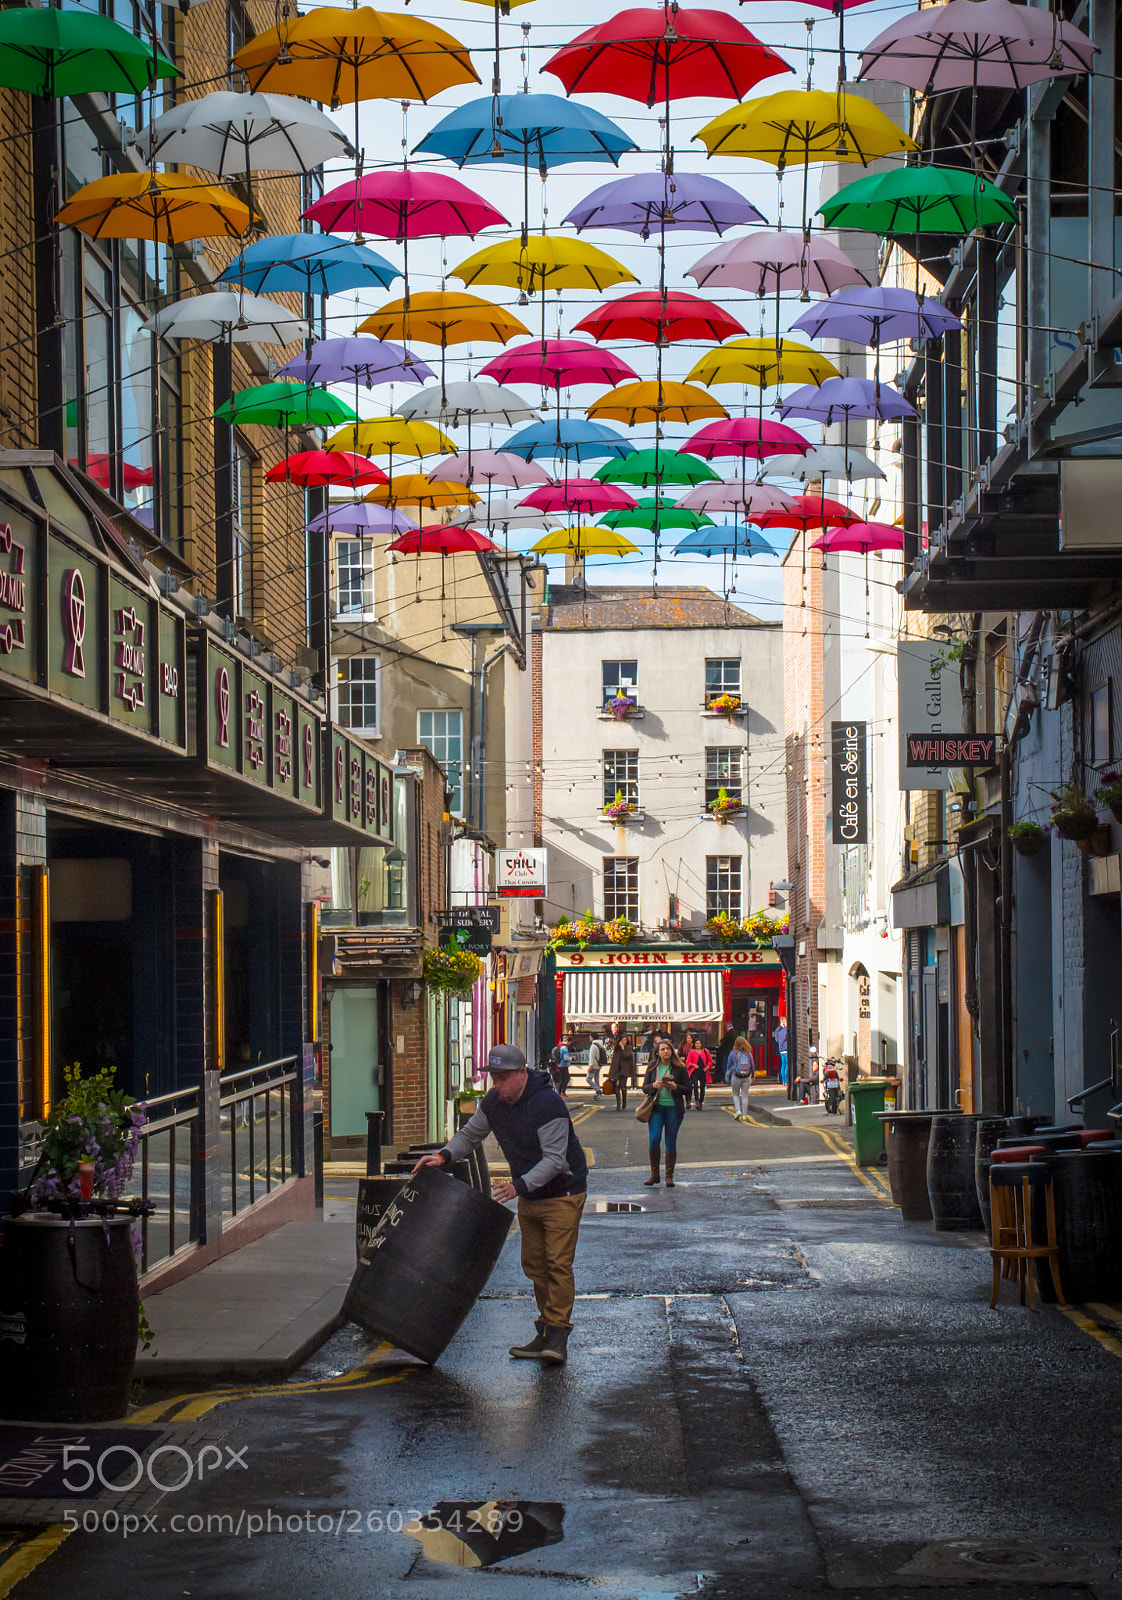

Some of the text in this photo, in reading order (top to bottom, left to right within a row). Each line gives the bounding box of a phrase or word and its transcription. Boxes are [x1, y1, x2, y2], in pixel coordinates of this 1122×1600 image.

[162, 662, 178, 697] BAR
[910, 740, 993, 761] WHISKEY
[840, 726, 859, 839] Café en Seine
[506, 859, 536, 869] CHILI
[570, 952, 763, 965] 9 JOHN KEHOE
